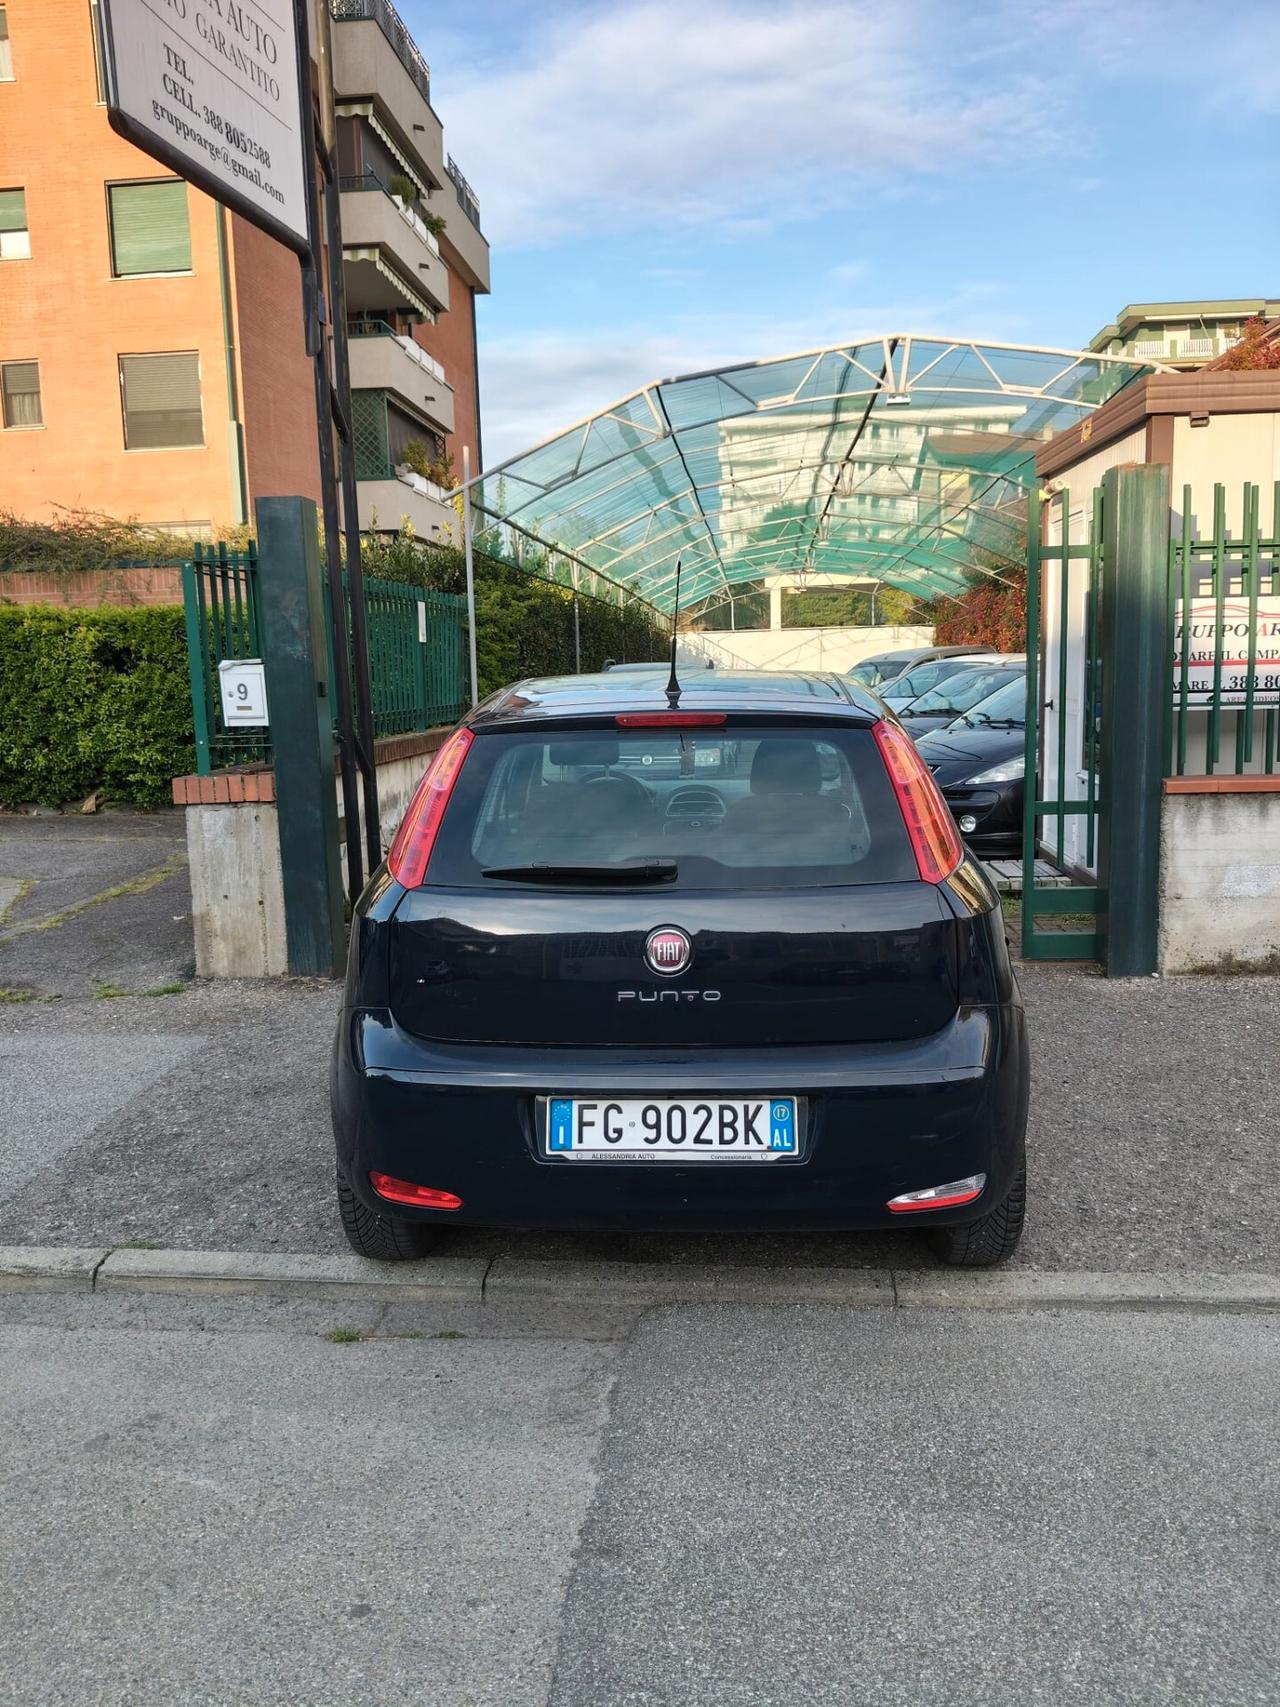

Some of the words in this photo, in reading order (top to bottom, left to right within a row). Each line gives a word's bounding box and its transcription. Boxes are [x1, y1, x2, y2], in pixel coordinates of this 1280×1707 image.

[227, 0, 277, 64] AUTO
[163, 42, 194, 85] TEL.
[195, 12, 280, 101] GARANTITO
[163, 73, 201, 118] CELL.
[203, 105, 224, 135] 388
[152, 99, 286, 205] gruppoarge@gmail.com
[237, 683, 248, 701] 9
[657, 942, 681, 961] FIAT
[617, 990, 721, 1002] PUNTO
[773, 1128, 791, 1147] AL
